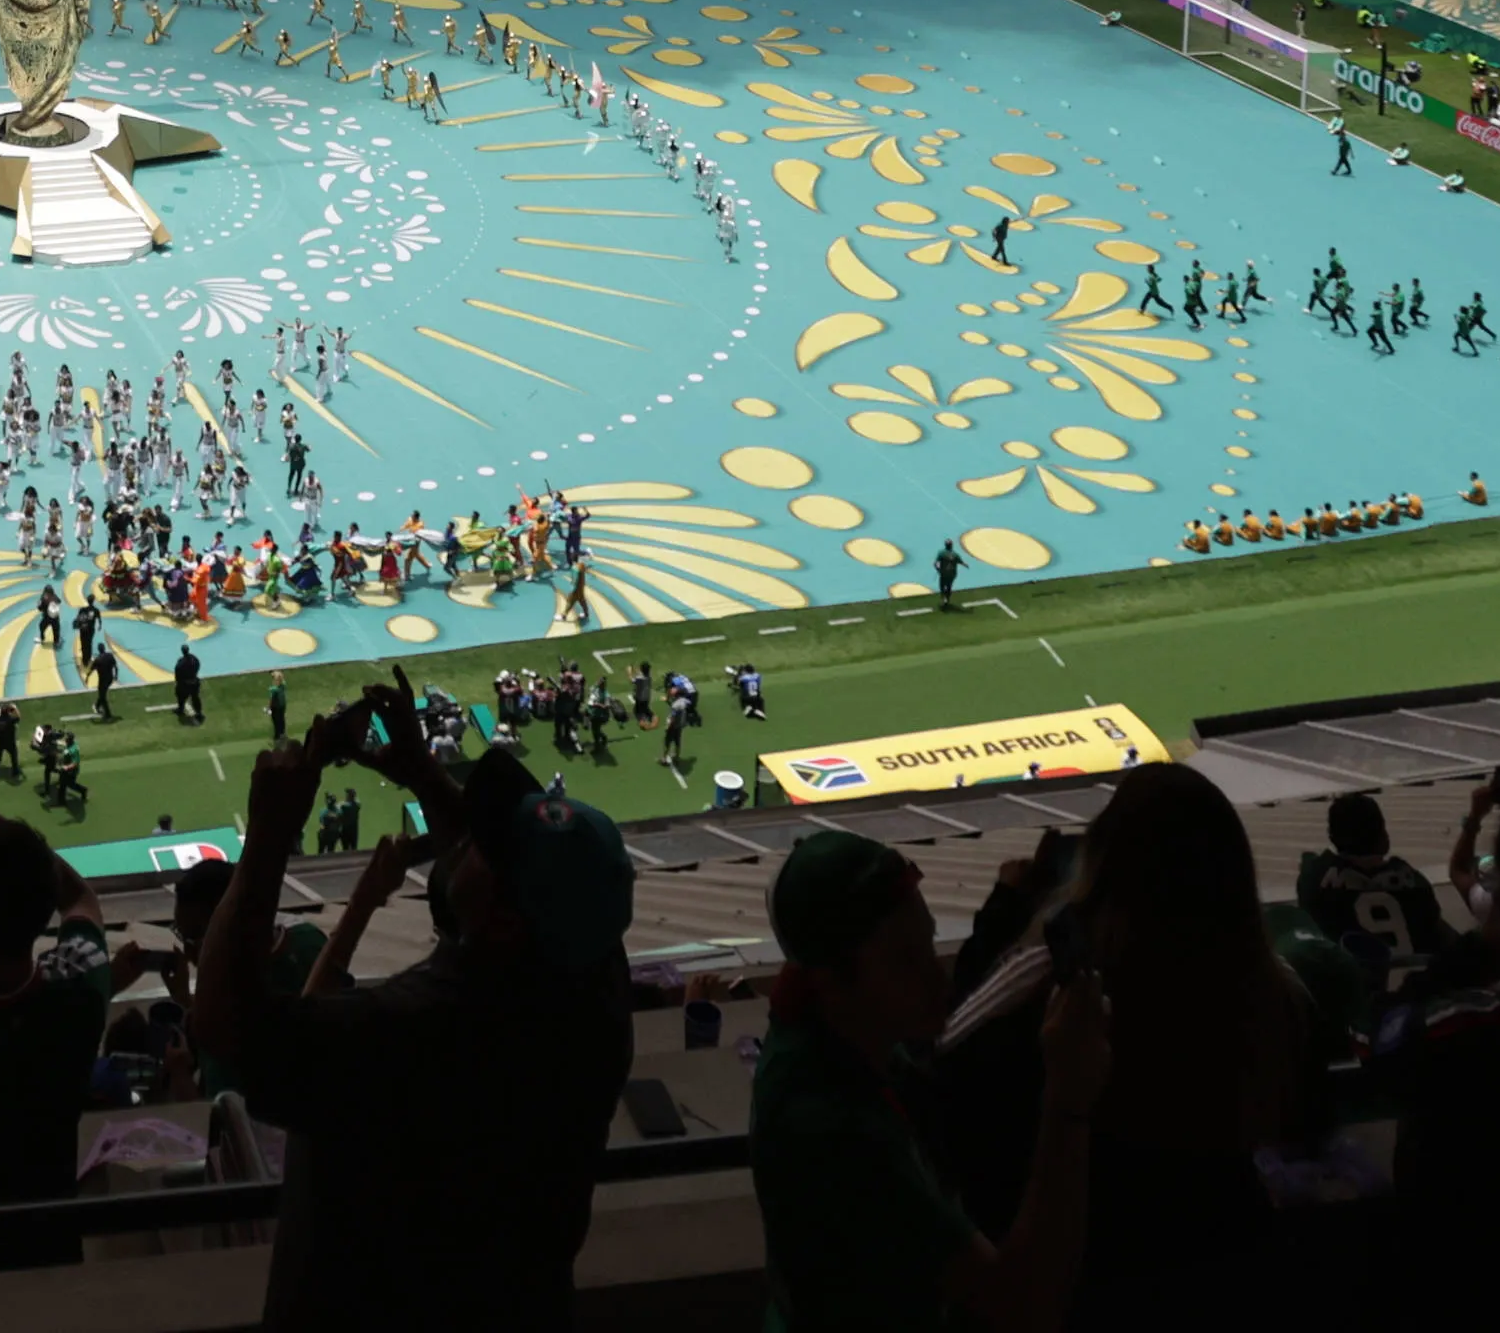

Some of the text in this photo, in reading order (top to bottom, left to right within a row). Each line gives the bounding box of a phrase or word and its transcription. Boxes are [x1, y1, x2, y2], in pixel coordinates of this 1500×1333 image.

[1332, 56, 1425, 115] aramco
[876, 729, 1088, 772] SOUTH AFRICA
[1353, 891, 1415, 956] 9
